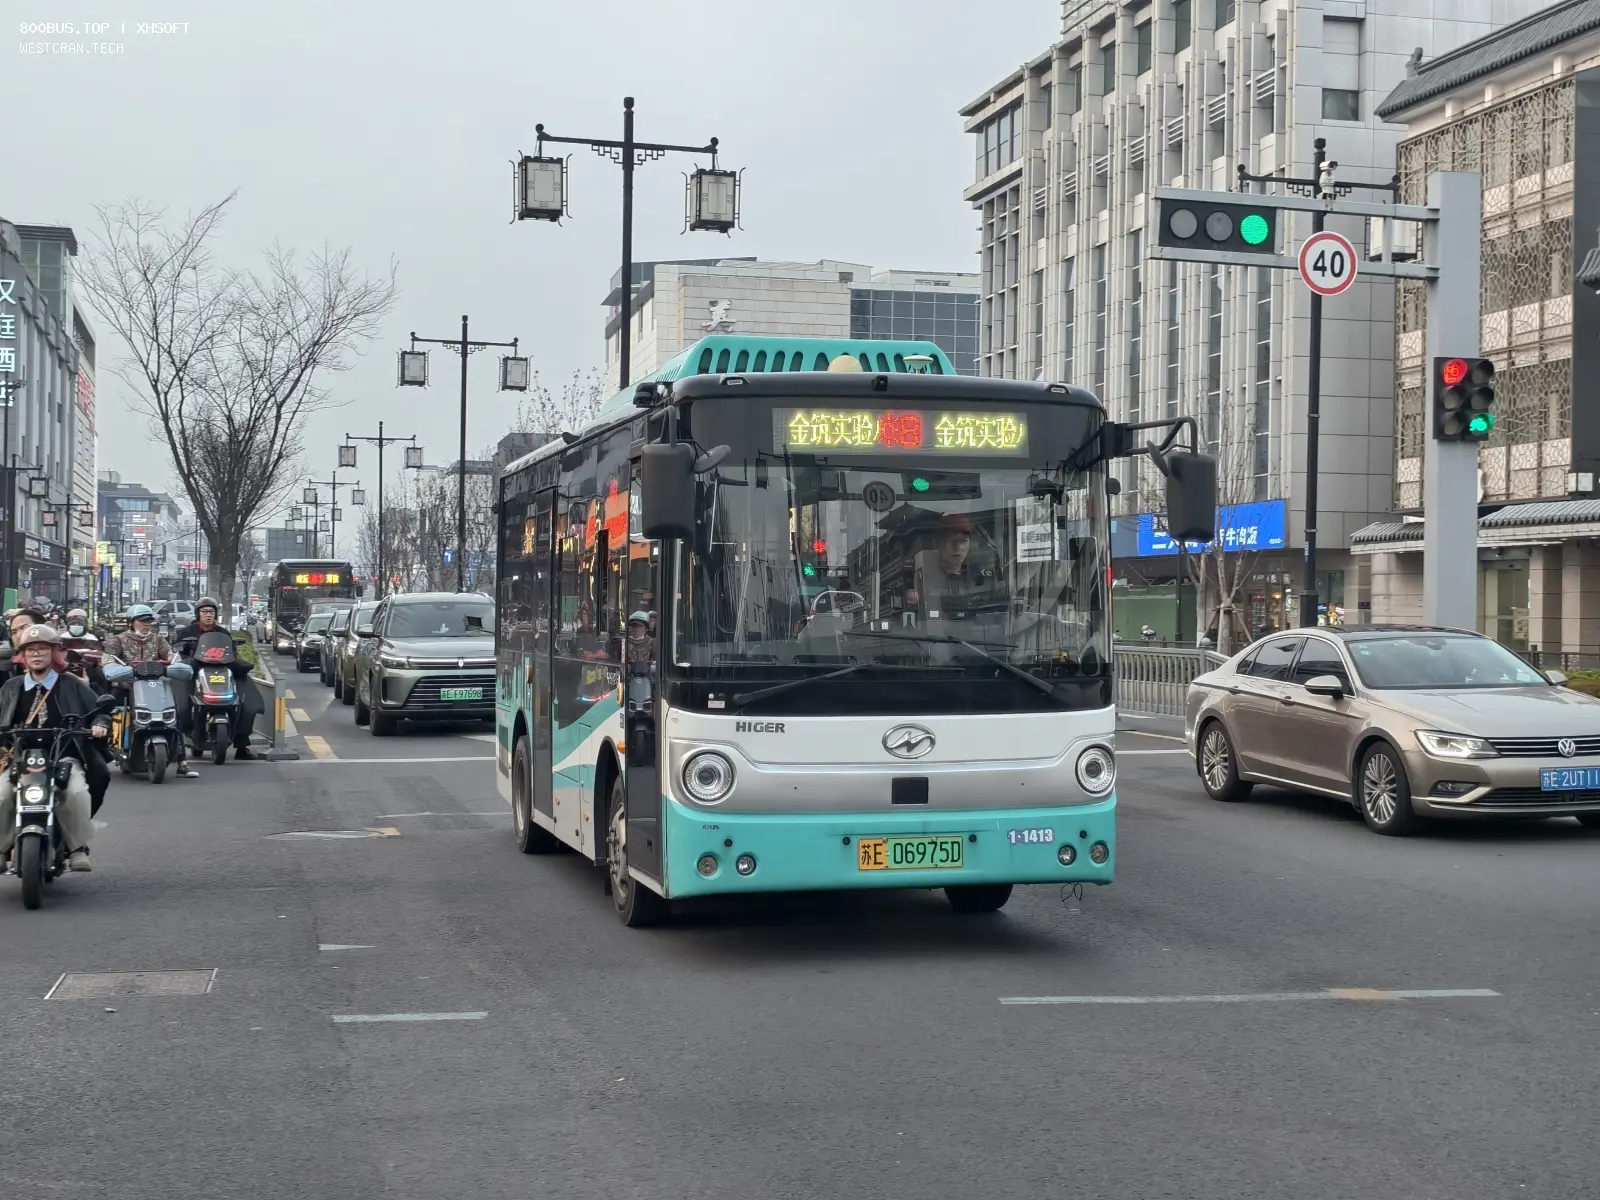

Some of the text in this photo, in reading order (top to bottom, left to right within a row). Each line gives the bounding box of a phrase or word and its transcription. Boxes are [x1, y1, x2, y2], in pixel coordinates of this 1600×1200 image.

[1312, 249, 1345, 278] 40
[788, 411, 878, 447] 金筑实验
[934, 415, 1025, 449] 金筑实验
[209, 675, 226, 684] 22
[735, 721, 786, 733] HIGER
